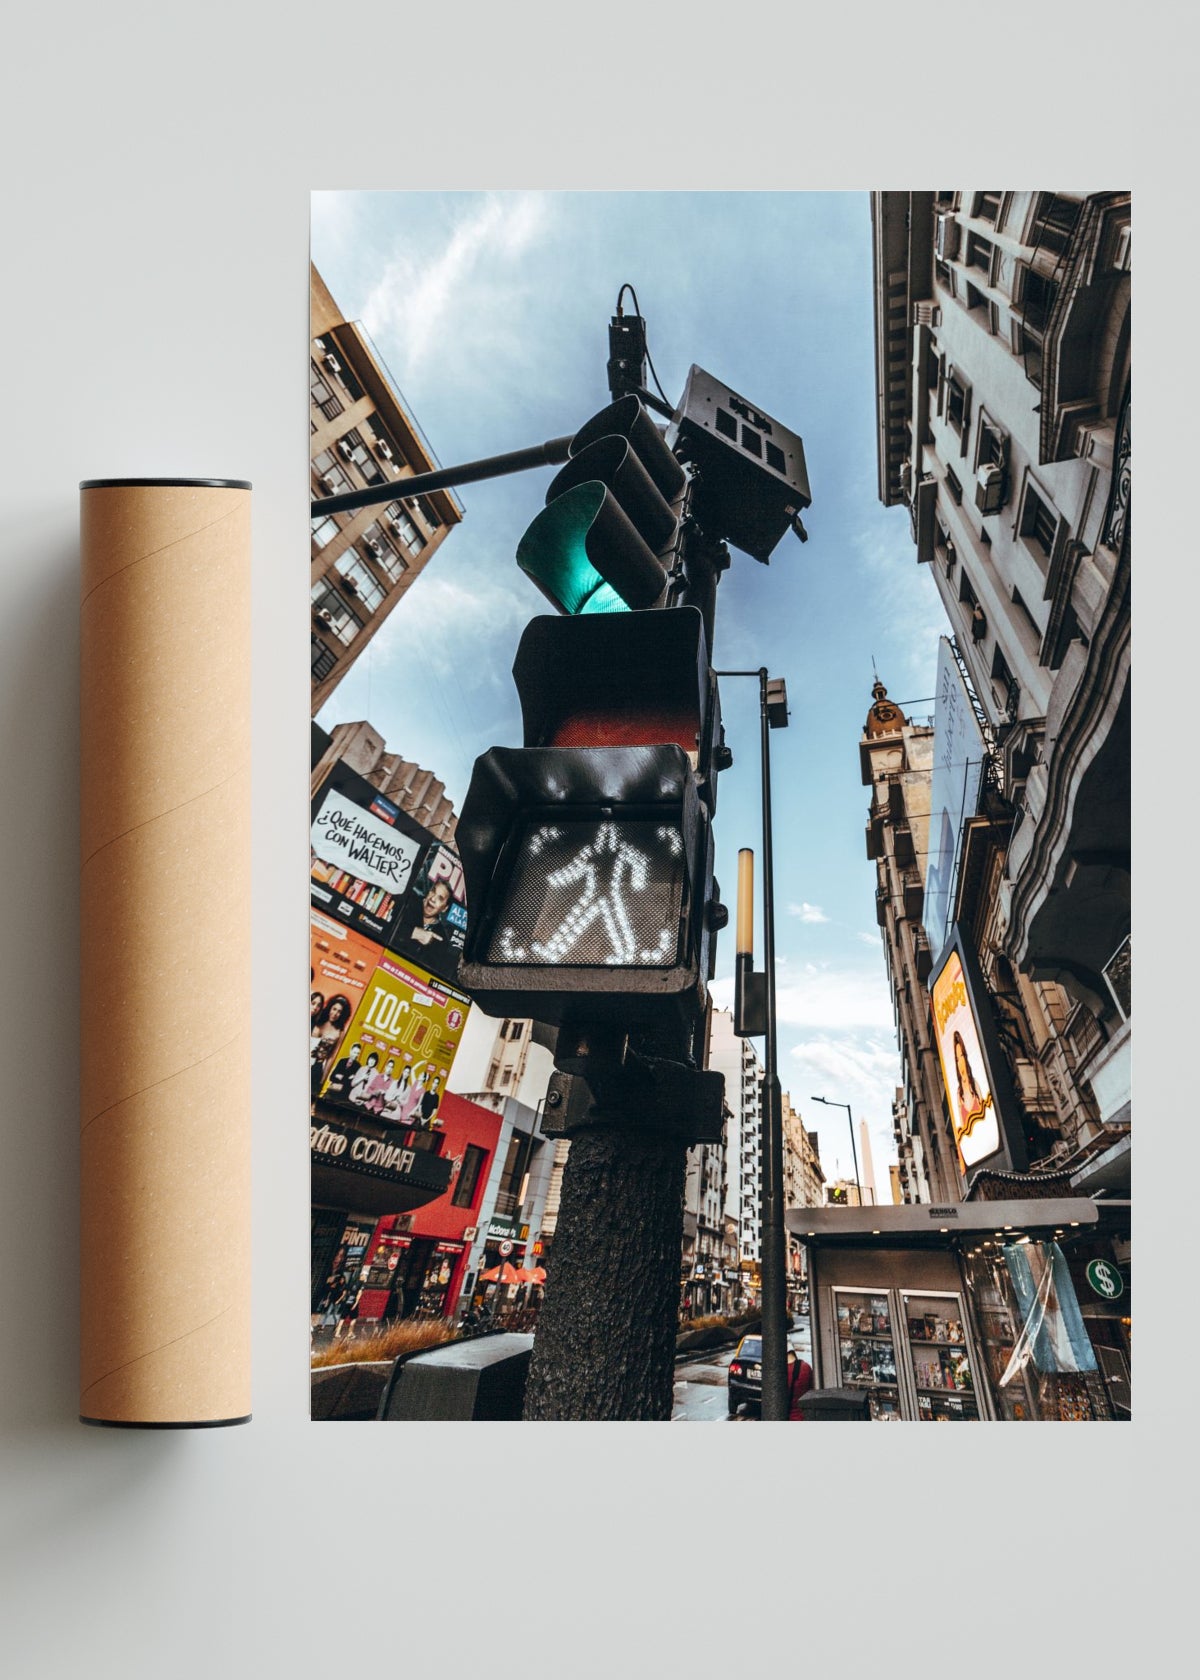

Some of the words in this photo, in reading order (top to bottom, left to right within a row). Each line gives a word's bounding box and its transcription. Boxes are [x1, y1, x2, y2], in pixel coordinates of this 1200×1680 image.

[317, 811, 357, 831] ¿QUÉ
[352, 824, 404, 861] HACEMOS
[325, 829, 349, 848] CON
[348, 839, 411, 883] WALTER?
[364, 986, 410, 1036] TOC
[401, 1008, 443, 1059] TOC
[350, 1136, 416, 1174] COMAFI
[340, 1230, 371, 1247] PINTI
